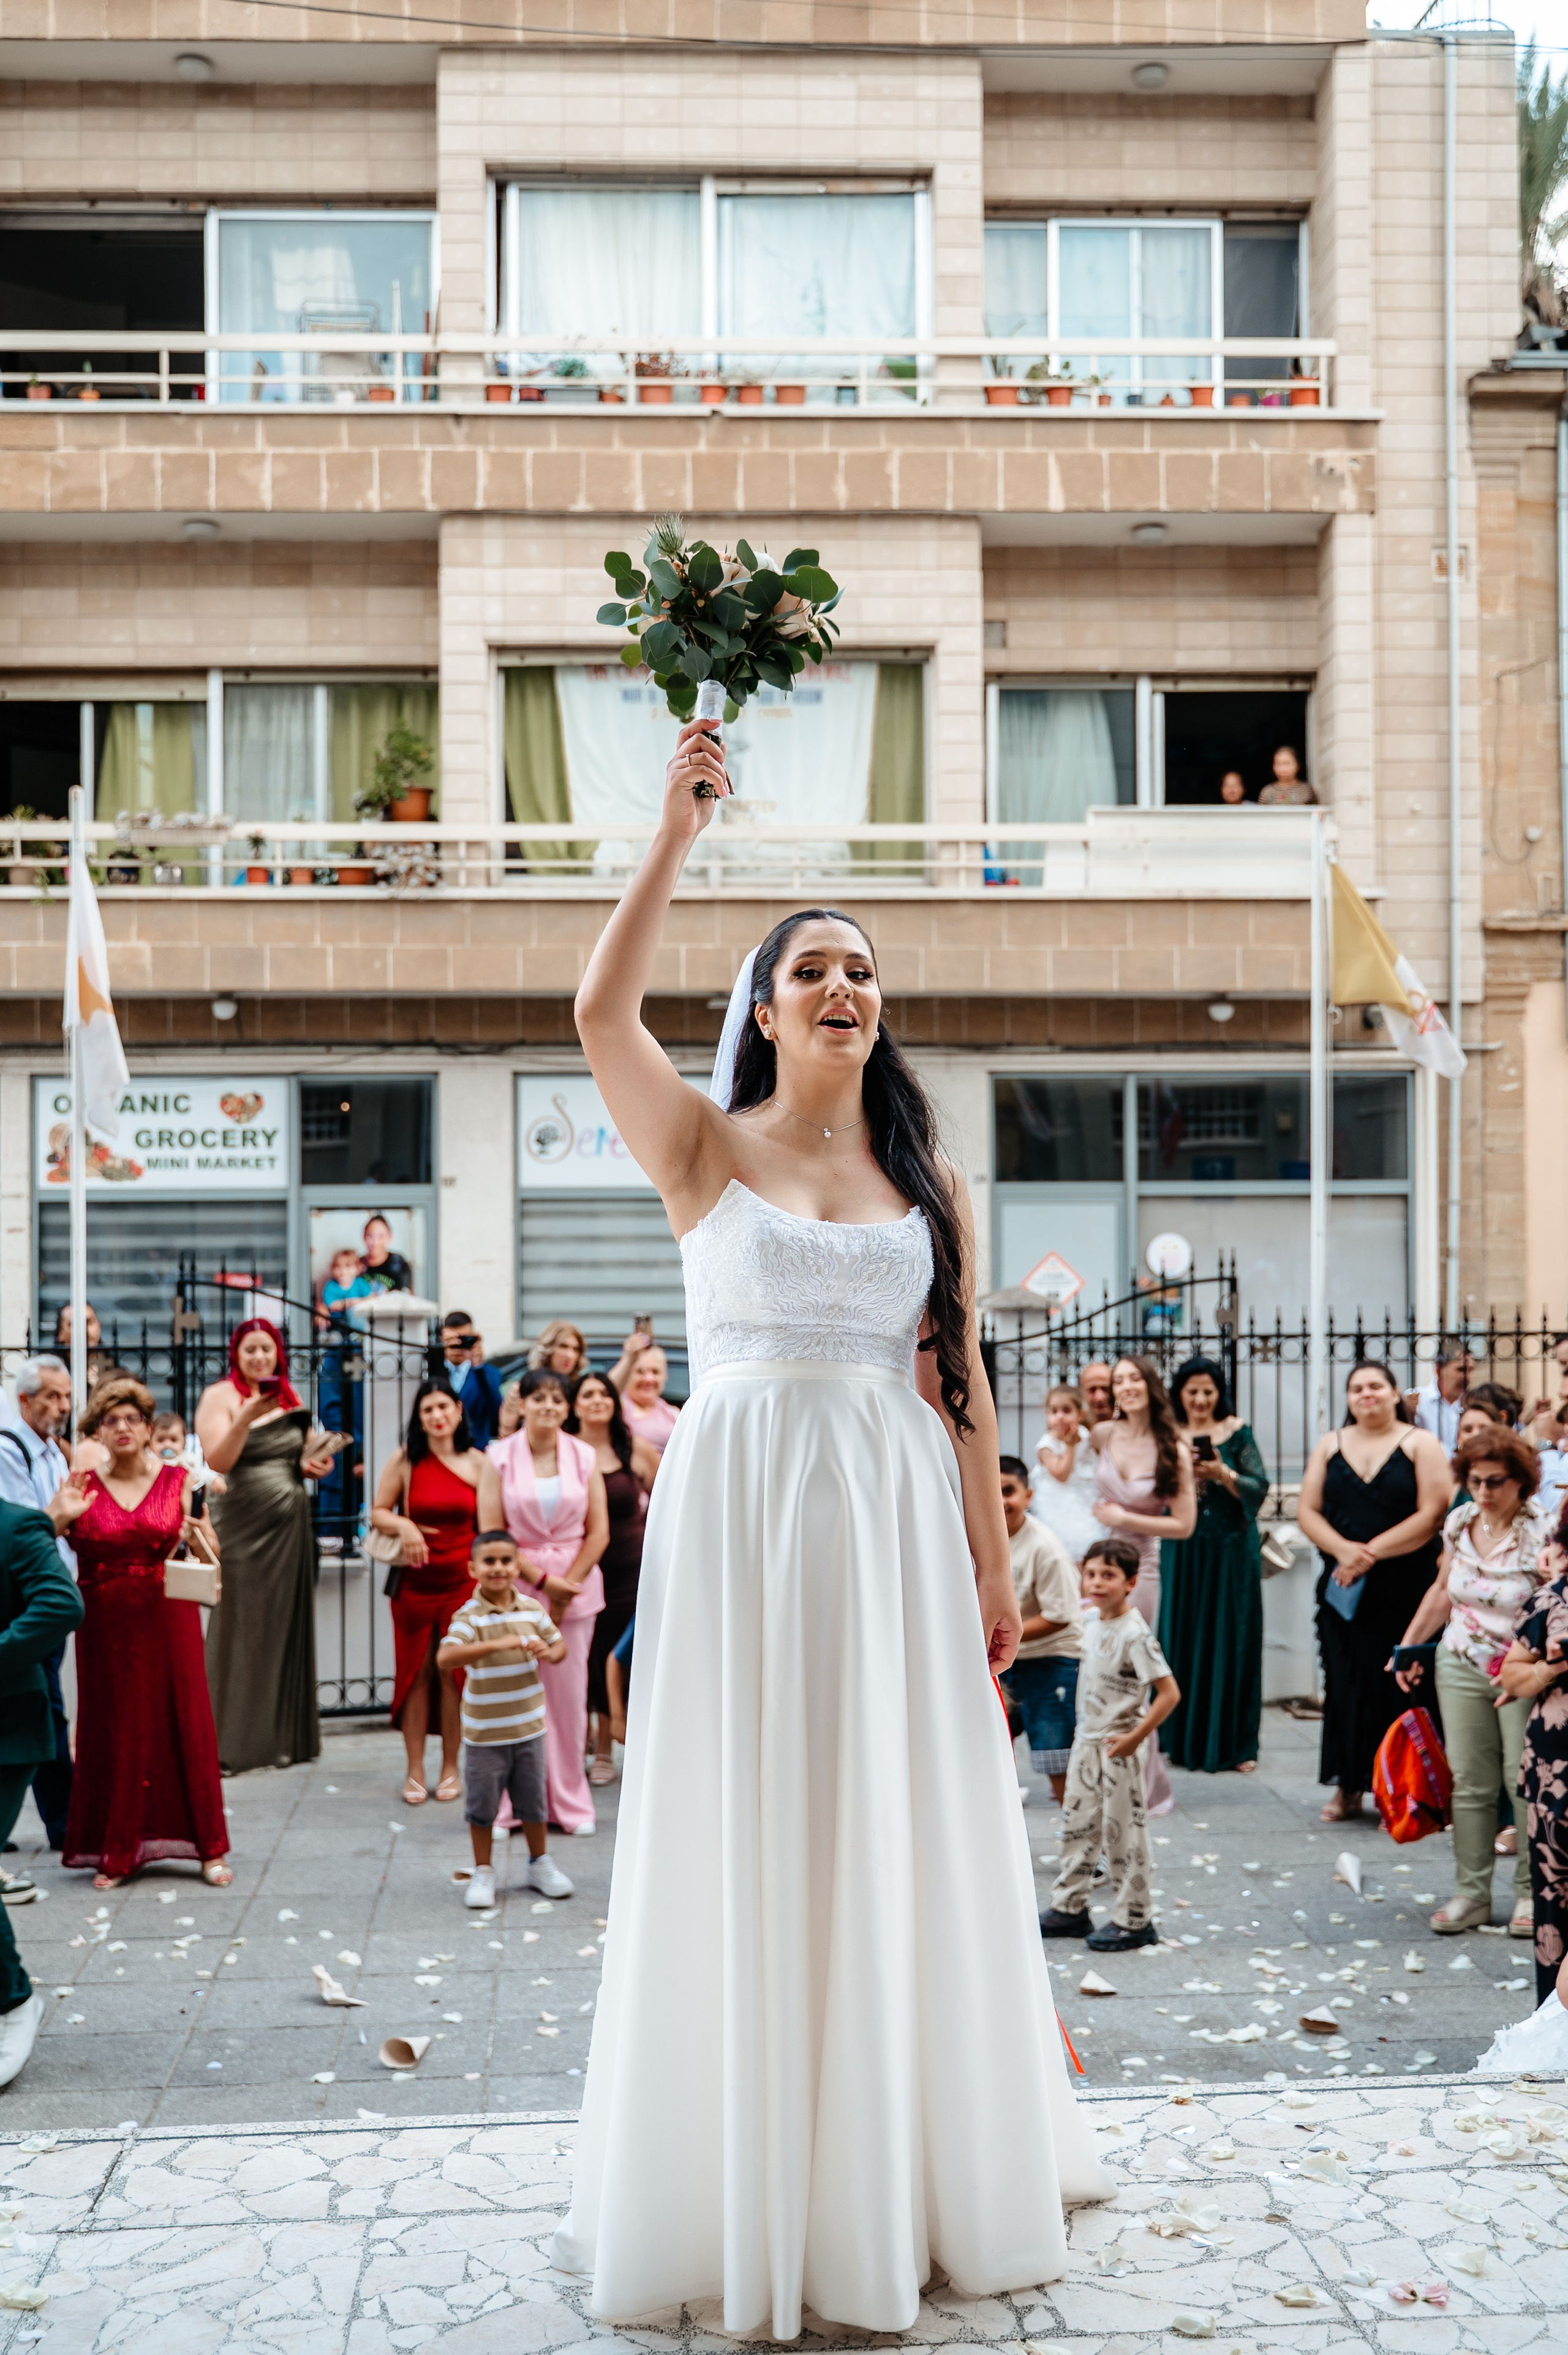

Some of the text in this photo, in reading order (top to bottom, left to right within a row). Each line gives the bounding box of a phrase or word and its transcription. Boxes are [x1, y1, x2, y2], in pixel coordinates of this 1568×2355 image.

[54, 1095, 189, 1113] OANIC
[135, 1130, 277, 1148] GROCERY
[147, 1157, 277, 1170] MINI MARKET
